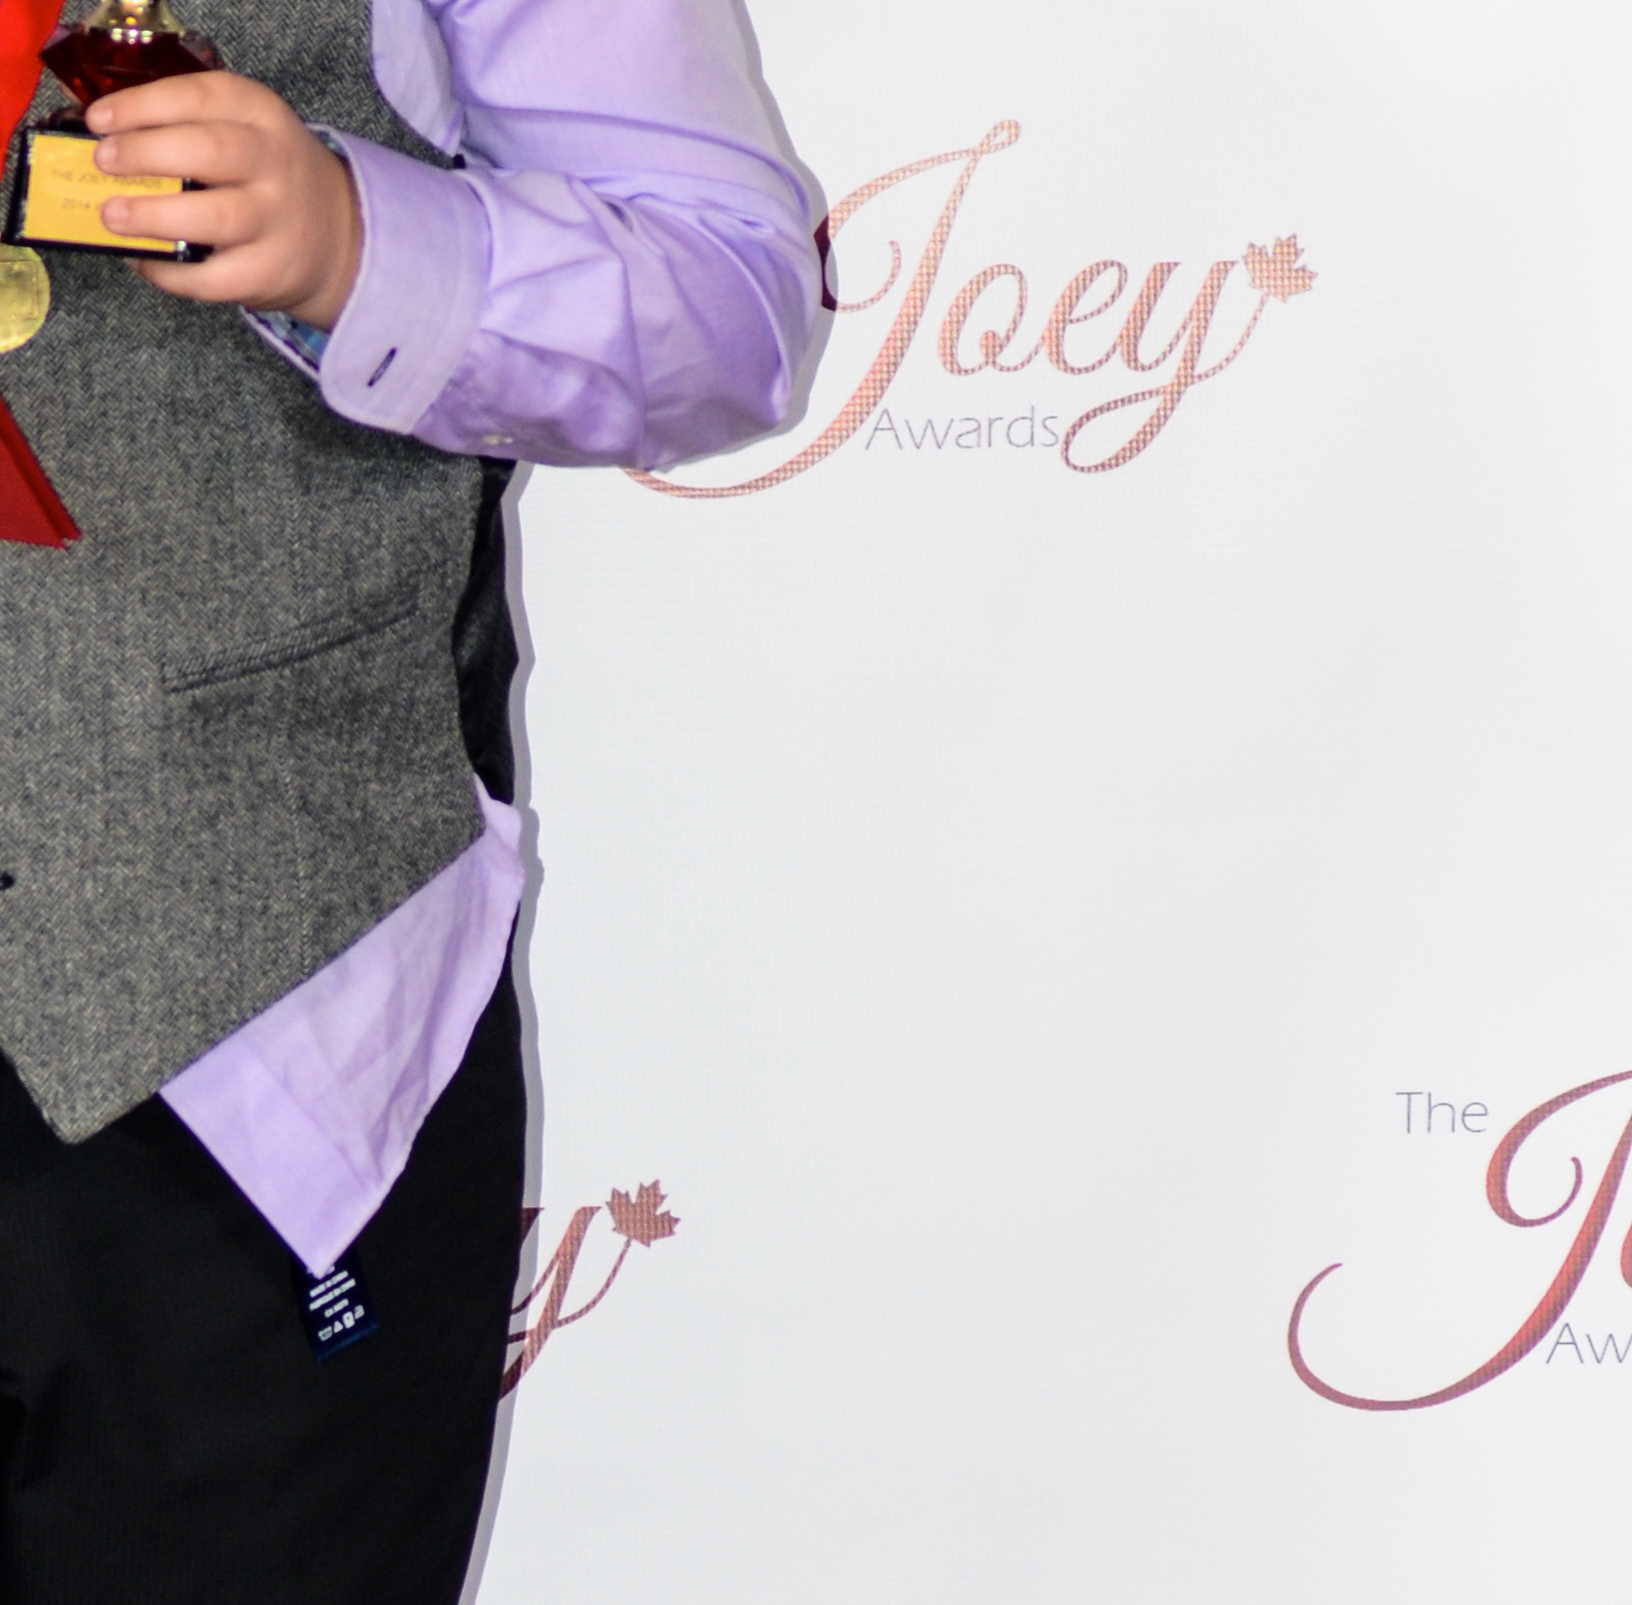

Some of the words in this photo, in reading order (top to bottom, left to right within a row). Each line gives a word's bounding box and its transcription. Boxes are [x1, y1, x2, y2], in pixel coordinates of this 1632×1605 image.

[620, 120, 1268, 498] Joey
[865, 406, 1060, 450] Awards
[1395, 1091, 1489, 1134] The
